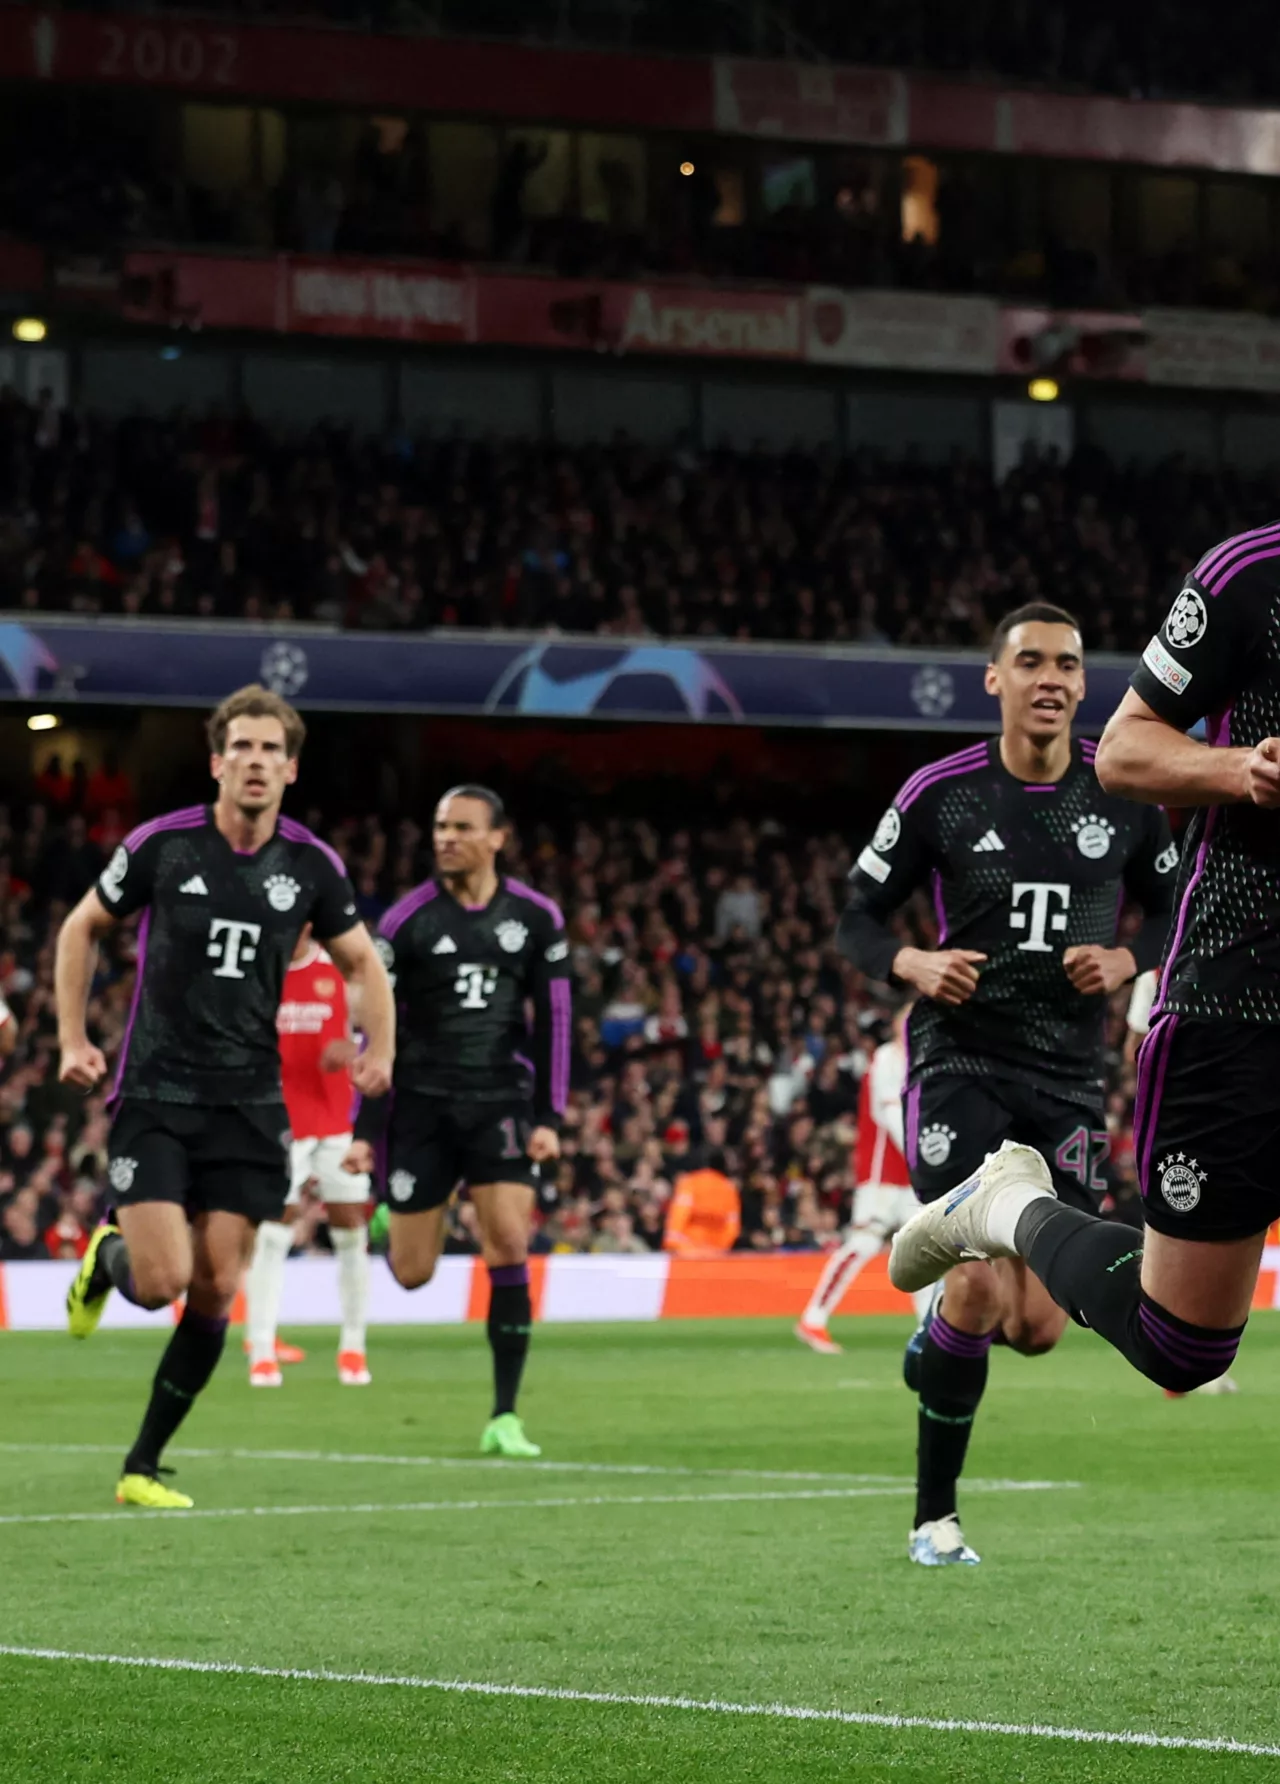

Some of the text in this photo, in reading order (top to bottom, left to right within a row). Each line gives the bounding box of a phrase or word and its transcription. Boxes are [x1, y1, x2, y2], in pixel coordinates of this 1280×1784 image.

[97, 25, 239, 85] 2002
[621, 287, 797, 351] Arsenal
[1010, 882, 1071, 952] T
[207, 918, 262, 979] T
[454, 963, 498, 1009] T
[1055, 1125, 1112, 1191] 42
